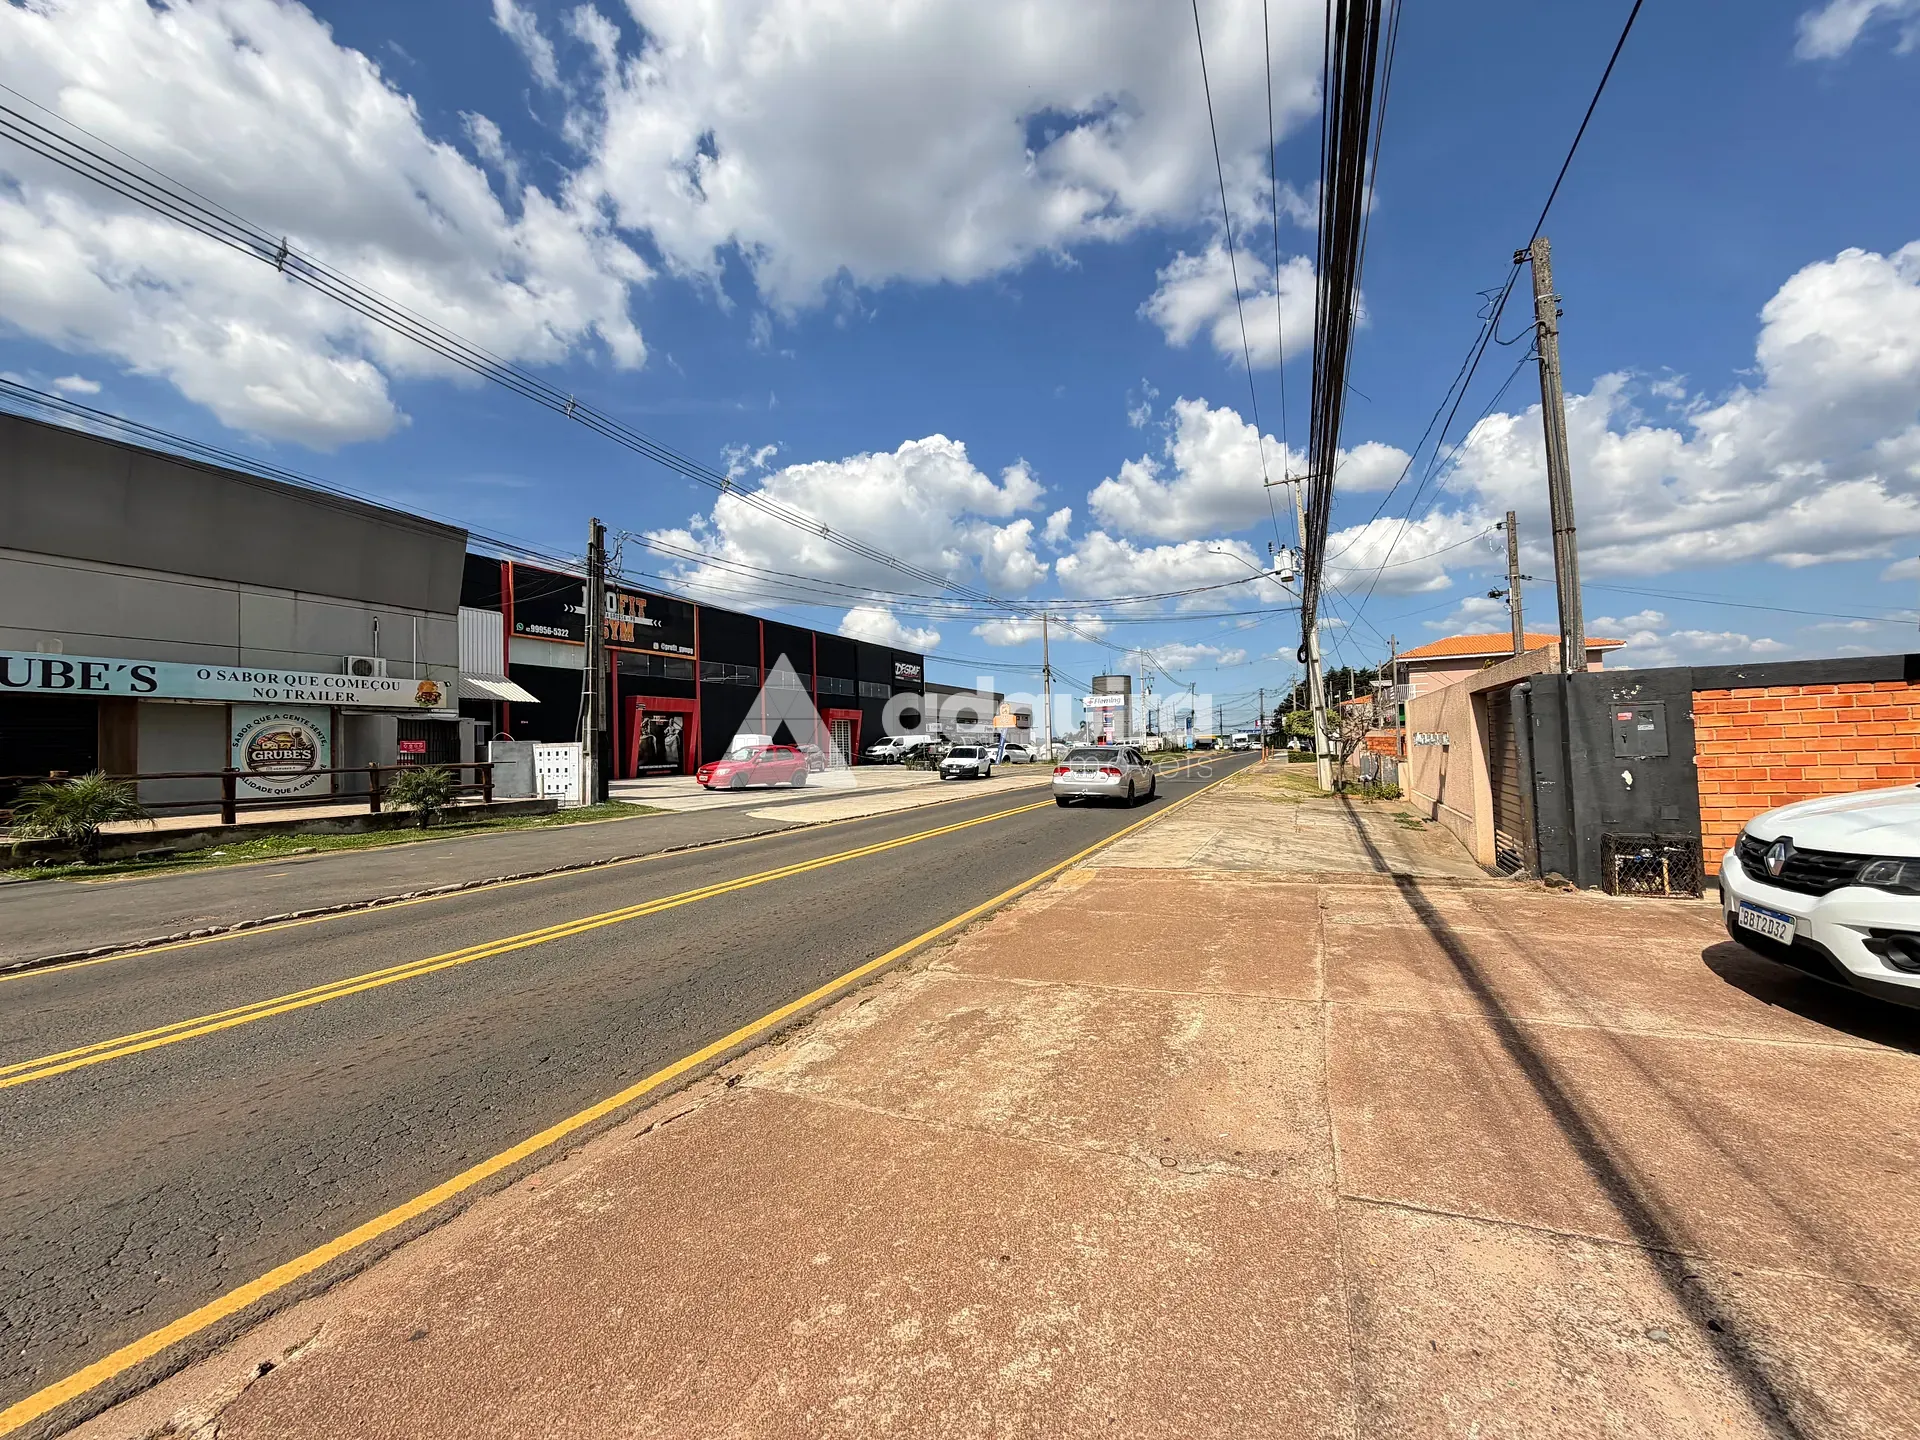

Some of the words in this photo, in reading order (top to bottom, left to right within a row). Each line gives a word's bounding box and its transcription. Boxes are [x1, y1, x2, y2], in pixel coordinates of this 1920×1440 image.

[196, 668, 211, 680] O
[216, 670, 278, 684] SABOR
[284, 675, 319, 687] QUE
[324, 677, 400, 692] COMEÇOU
[252, 687, 278, 699] NO
[282, 688, 360, 703] TRAILER.
[232, 723, 253, 748] SABOR
[253, 714, 272, 725] QUE
[282, 713, 309, 726] GENTE
[274, 787, 292, 795] QUE
[1743, 910, 1787, 940] BBT2D32
